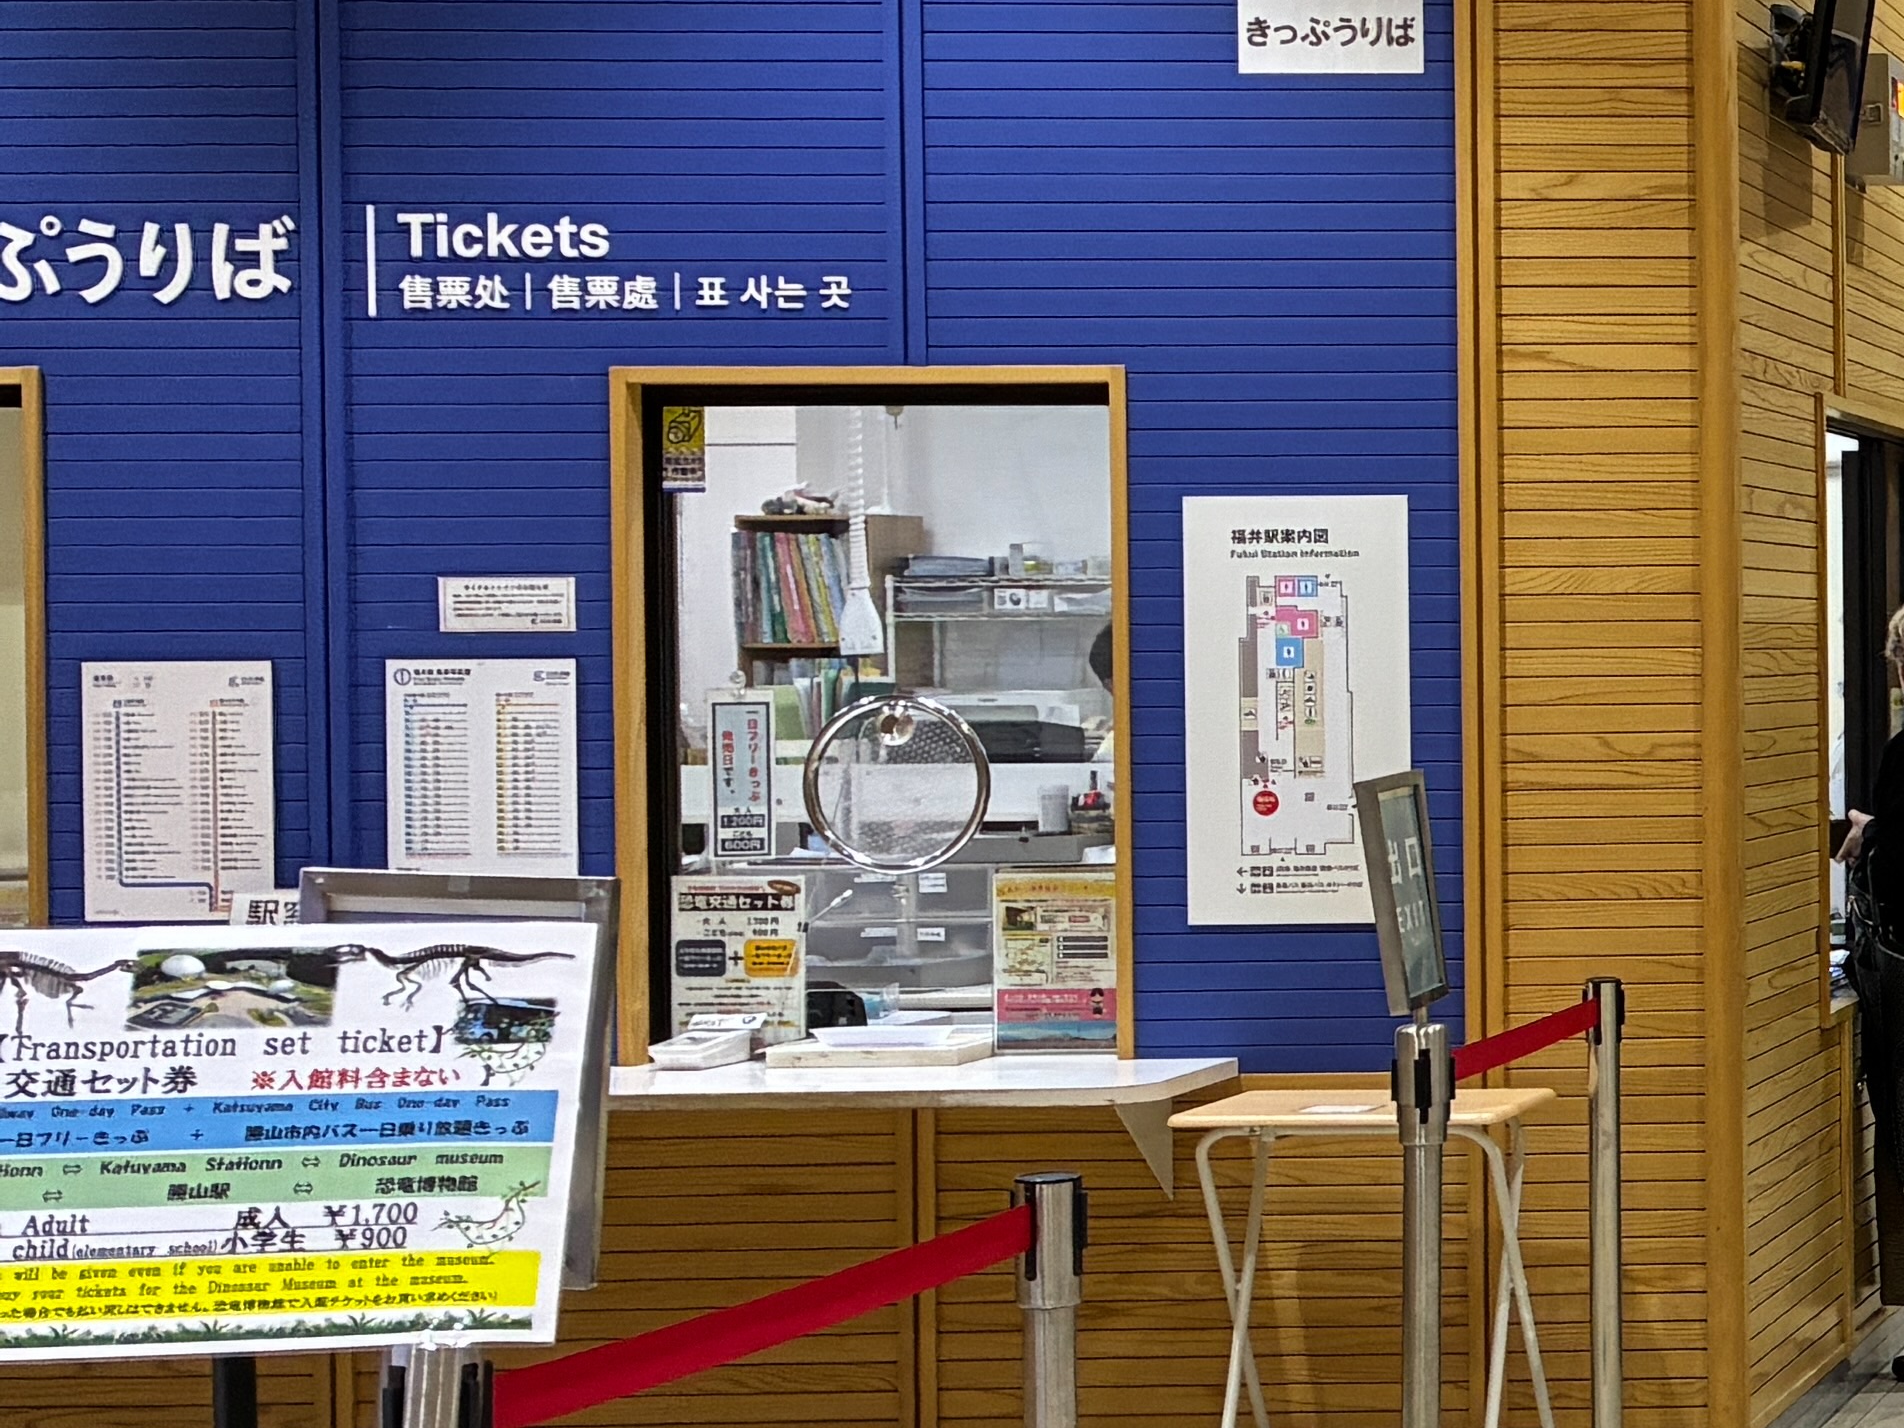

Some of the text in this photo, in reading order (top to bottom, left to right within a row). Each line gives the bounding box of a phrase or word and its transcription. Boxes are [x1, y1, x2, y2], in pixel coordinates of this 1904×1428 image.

[1245, 15, 1416, 48] きっぷうりば
[398, 212, 611, 259] Tickets
[398, 275, 852, 310] 售票处 售票處 표 사는 곳
[1230, 528, 1329, 545] 福井駅案内図
[1395, 899, 1426, 933] EXIT
[263, 1032, 312, 1056] set
[4, 1065, 198, 1100] 交通セット券
[130, 1094, 510, 1117] Pass Katsuyama City Bus Pass
[338, 1152, 417, 1169] Dinosaur
[434, 1152, 504, 1166] museum
[166, 1174, 479, 1202] 勝山駅 恐竜博物館
[21, 1213, 91, 1237] Adult
[232, 1205, 293, 1230] 成人
[220, 1229, 307, 1256] 小学生
[51, 1254, 425, 1280] be you are to enter the
[76, 1273, 400, 1299] tickets for the Dinosaur Museum at the
